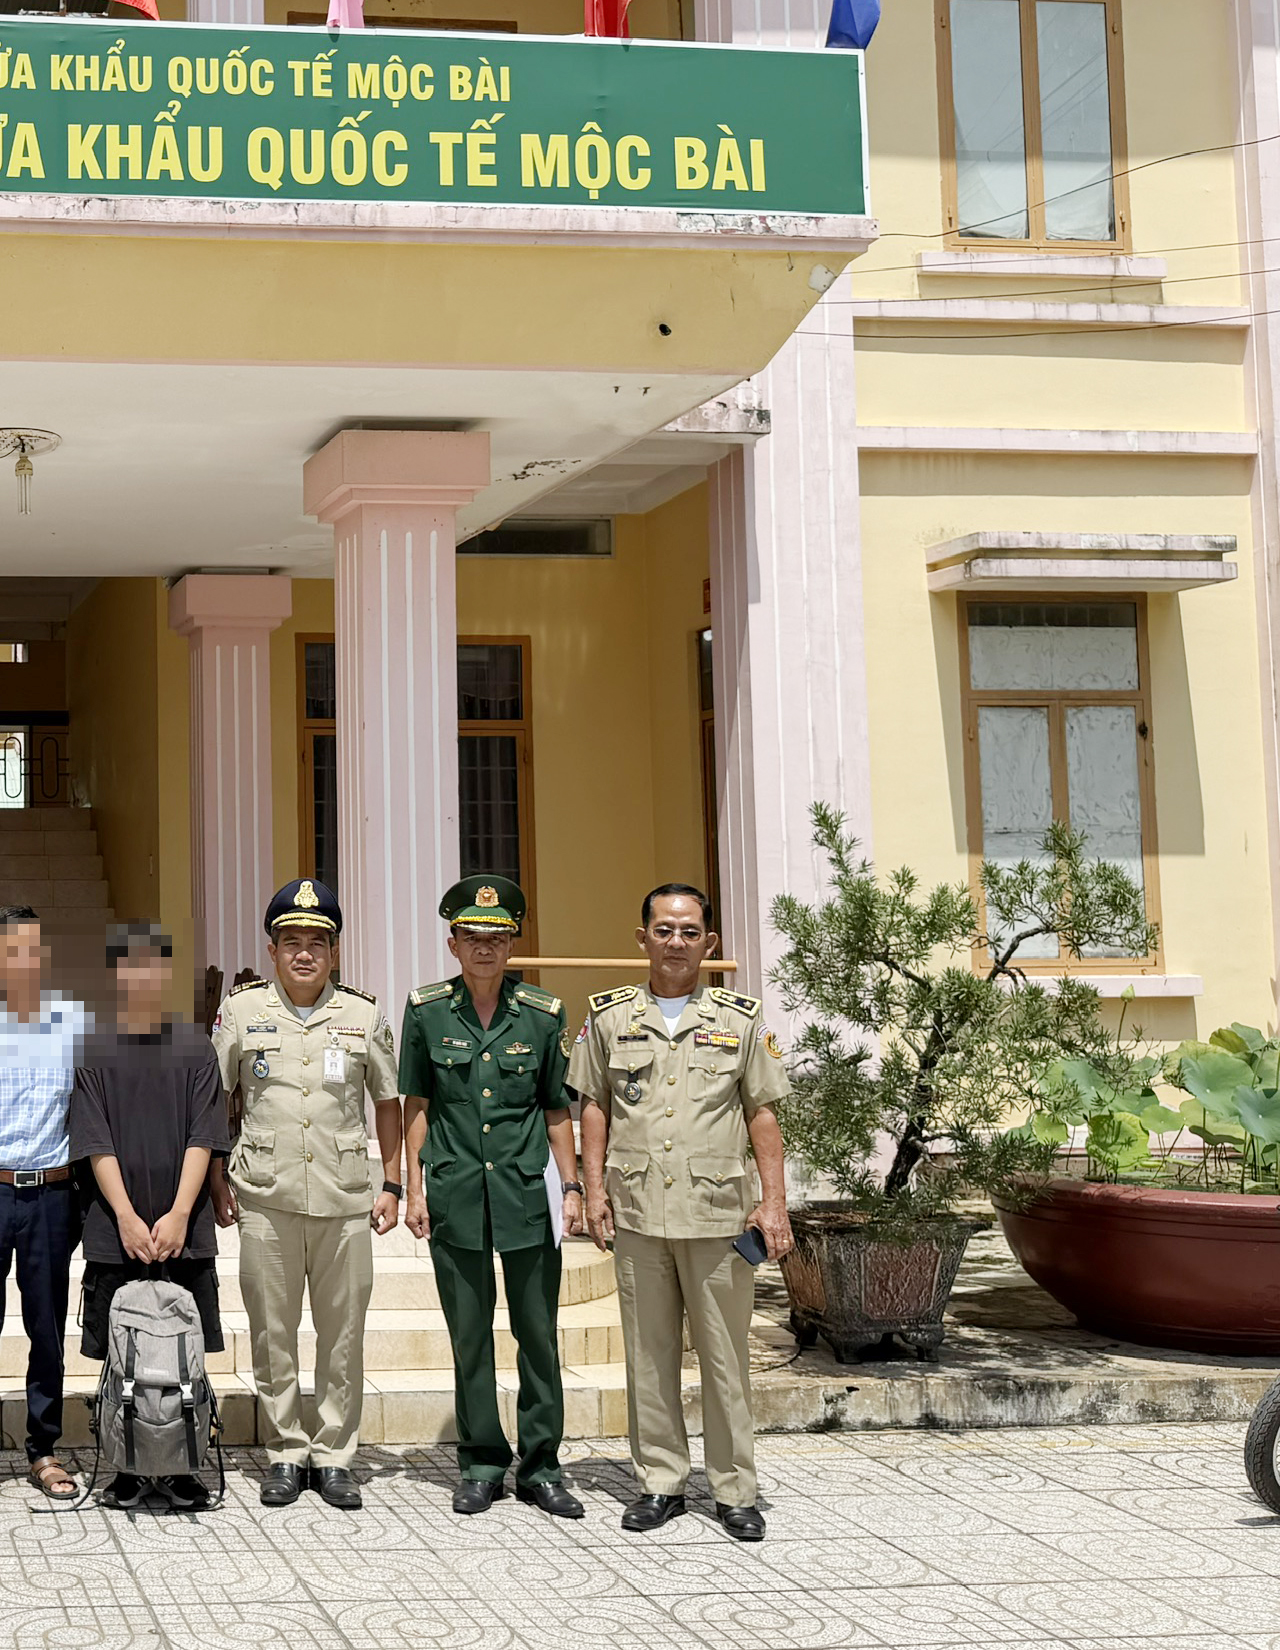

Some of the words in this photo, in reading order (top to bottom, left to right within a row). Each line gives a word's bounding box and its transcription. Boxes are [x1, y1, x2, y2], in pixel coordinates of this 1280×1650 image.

[49, 38, 153, 93] KHẨU
[167, 45, 275, 98] QUỐC
[286, 49, 334, 98] TẾ
[346, 54, 435, 108] MỘC
[448, 55, 511, 102] BÀI
[66, 100, 223, 183] KHẨU
[247, 110, 410, 191] QUỐC
[429, 113, 504, 187] TẾ
[520, 121, 652, 199] MỘC
[674, 124, 767, 192] BÀI
